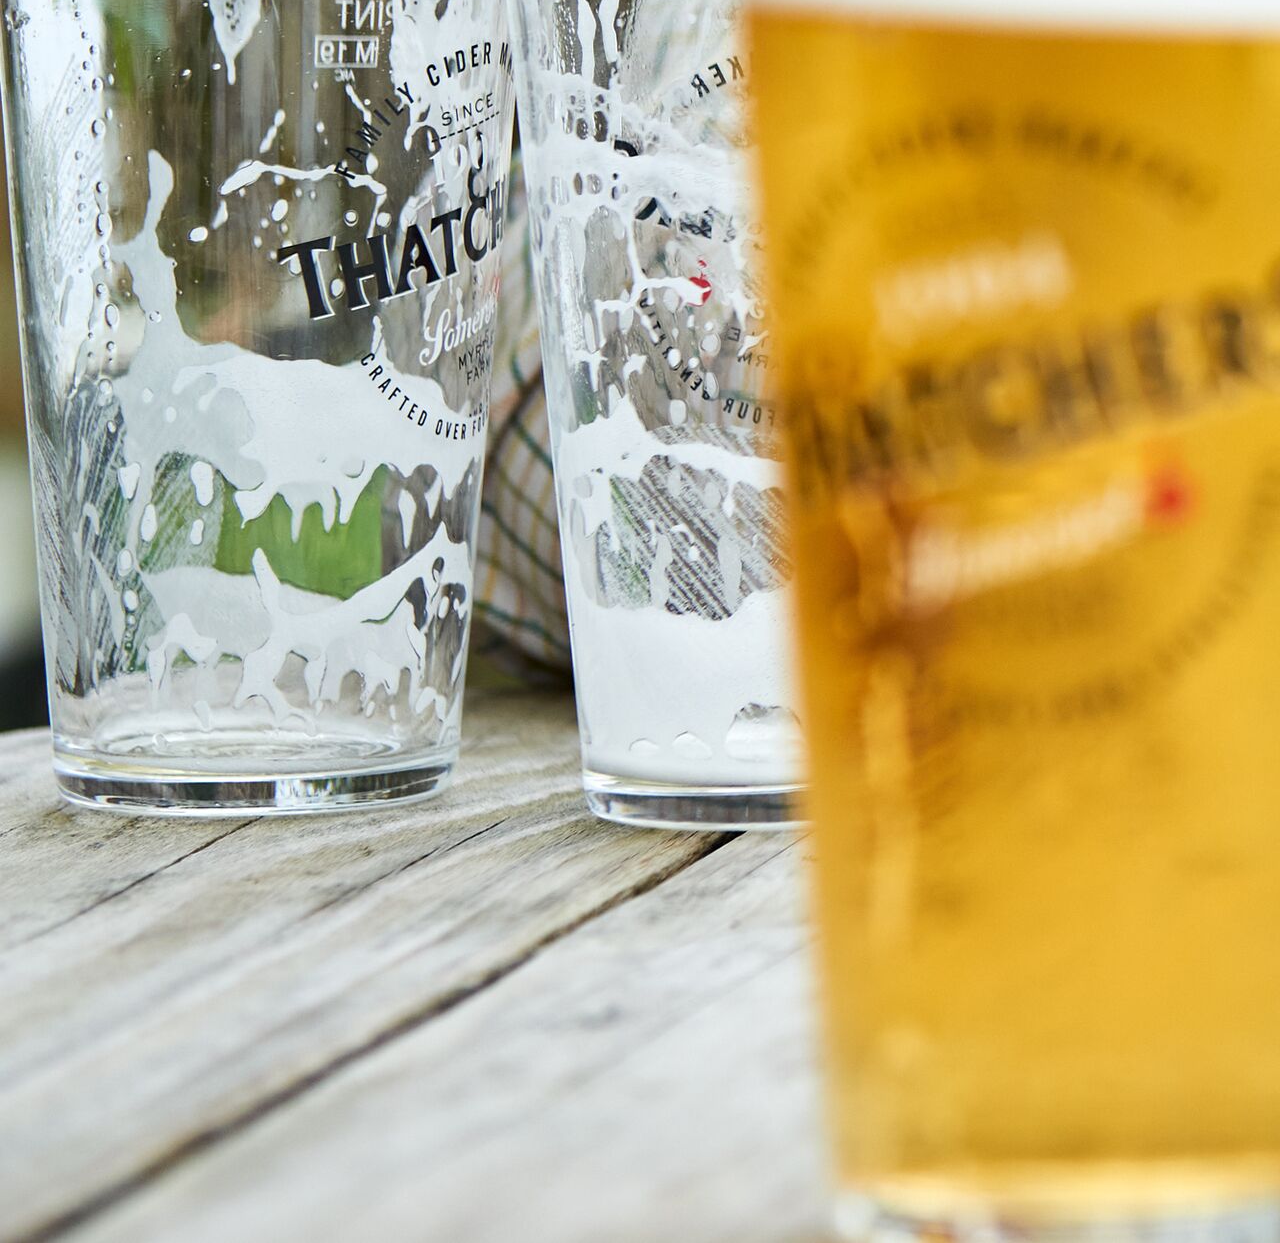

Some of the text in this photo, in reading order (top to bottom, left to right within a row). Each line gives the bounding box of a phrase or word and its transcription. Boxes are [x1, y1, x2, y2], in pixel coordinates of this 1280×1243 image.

[334, 81, 414, 179] FAMILY
[426, 42, 491, 86] CIDER
[441, 92, 493, 127] SINCE
[360, 353, 427, 427] CRAFTED
[435, 419, 467, 440] OVER
